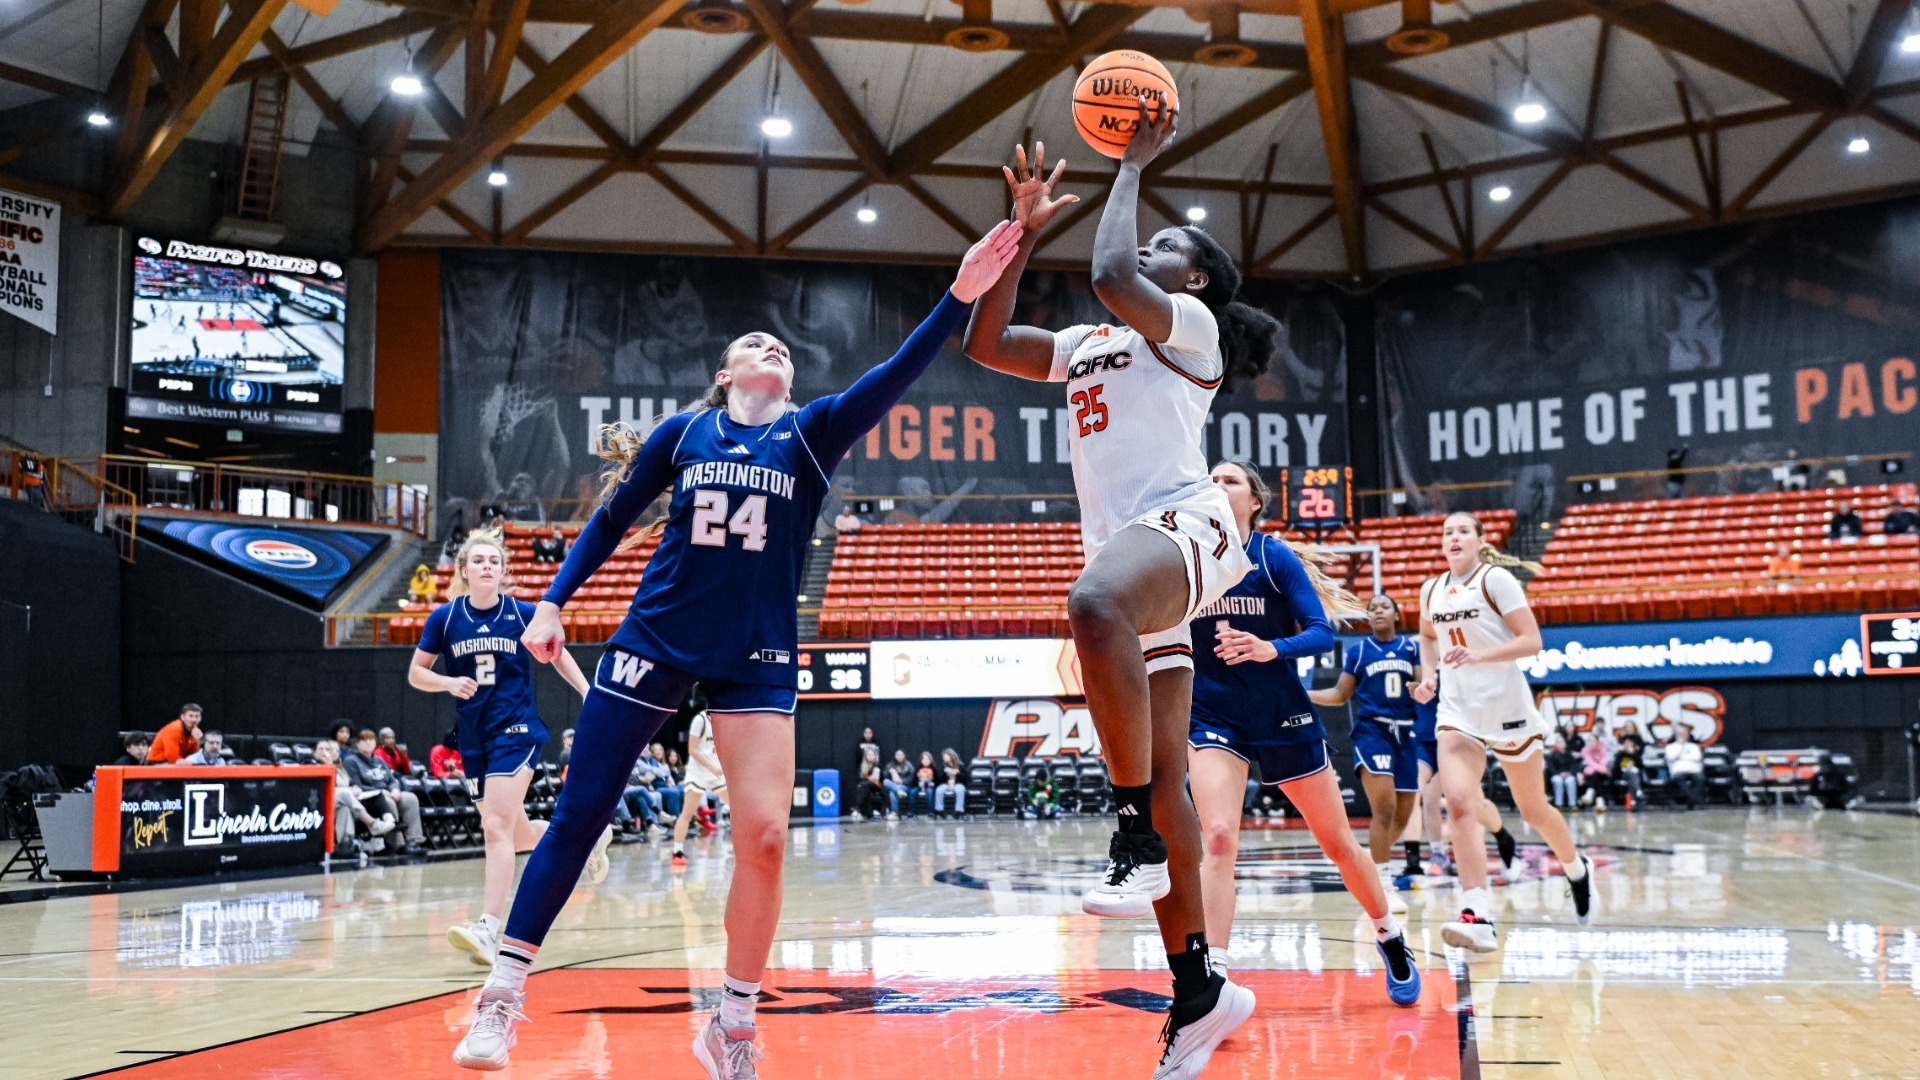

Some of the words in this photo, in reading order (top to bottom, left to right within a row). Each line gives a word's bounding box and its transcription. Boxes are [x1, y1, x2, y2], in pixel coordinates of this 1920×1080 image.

[1092, 78, 1164, 101] Wilson
[1098, 114, 1141, 133] NCA
[0, 195, 54, 219] RSITY
[1066, 350, 1132, 384] ACIFIC
[157, 402, 185, 416] Best
[188, 404, 238, 420] Western
[239, 409, 270, 422] PLUS
[1071, 383, 1108, 438] 25
[1428, 397, 1564, 462] HOME
[1584, 387, 1647, 446] OF
[1667, 373, 1773, 438] THE
[1794, 357, 1918, 424] PAC
[842, 404, 997, 462] IGER
[682, 461, 796, 500] WASHINGTON
[1303, 467, 1338, 486] 2:59
[1298, 487, 1335, 519] 26
[690, 489, 768, 552] 24
[1195, 596, 1266, 619] SHINGTON
[1431, 608, 1480, 625] PACIFIC
[452, 636, 518, 659] WASHINGTON
[1448, 626, 1468, 648] 11
[475, 653, 496, 686] 2
[611, 650, 655, 689] W
[825, 653, 867, 668] WASH
[1384, 671, 1402, 699] 0
[977, 697, 1104, 761] PA
[1371, 753, 1392, 770] W
[268, 802, 325, 832] Center
